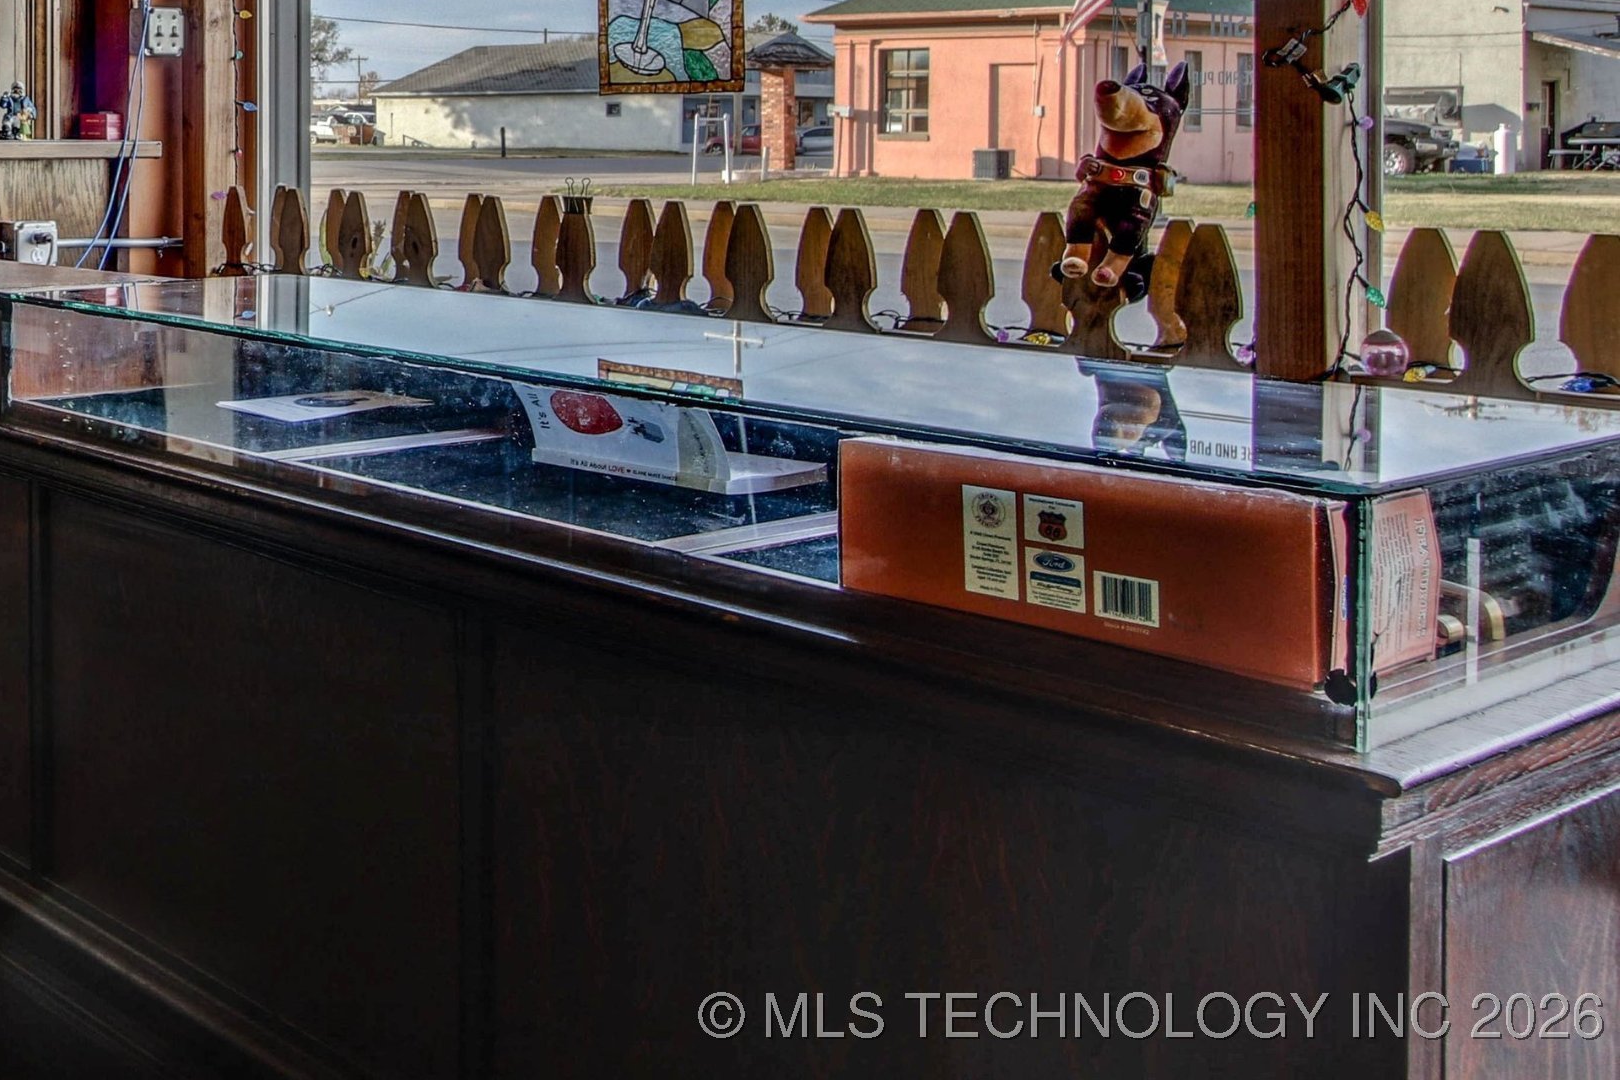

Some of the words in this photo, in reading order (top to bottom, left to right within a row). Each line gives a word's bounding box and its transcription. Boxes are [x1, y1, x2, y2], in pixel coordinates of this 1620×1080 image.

[1190, 439, 1212, 456] PUB
[608, 465, 625, 474] LOVE
[1042, 559, 1065, 569] Ford
